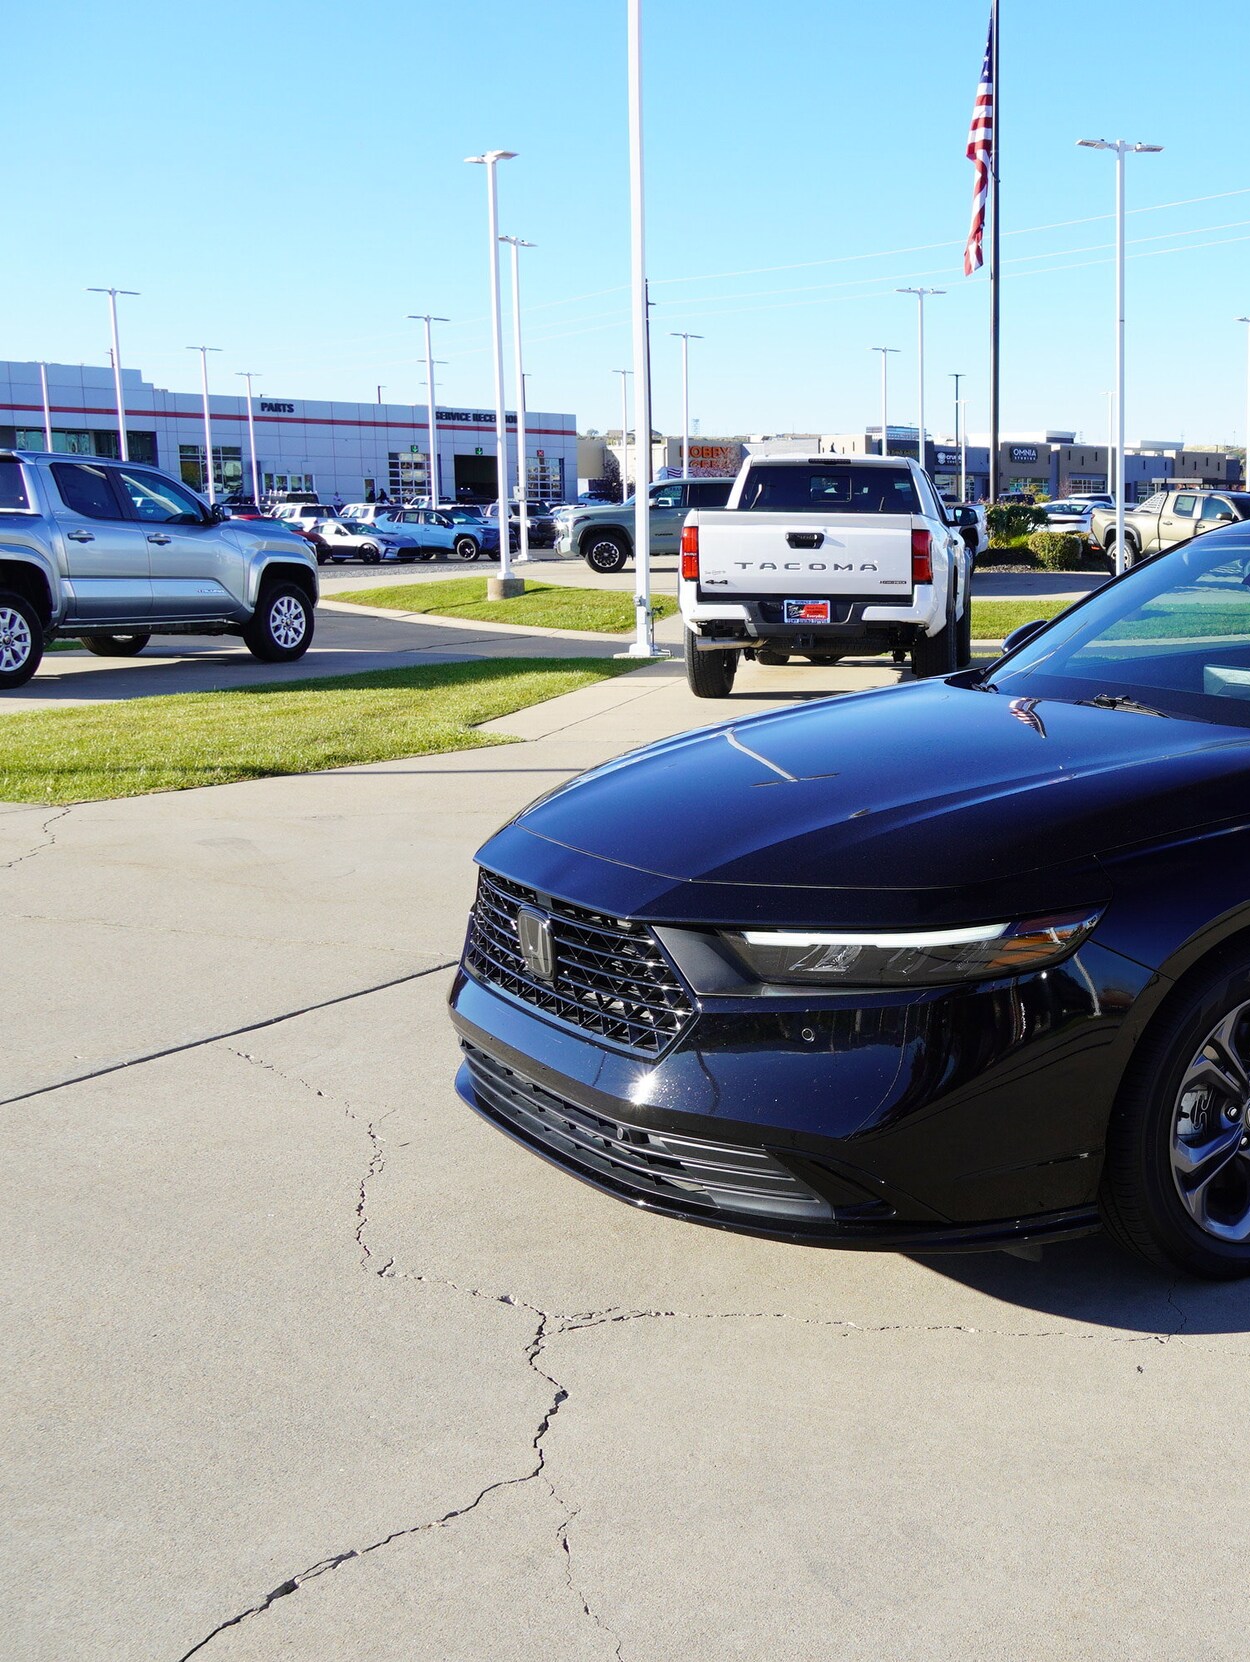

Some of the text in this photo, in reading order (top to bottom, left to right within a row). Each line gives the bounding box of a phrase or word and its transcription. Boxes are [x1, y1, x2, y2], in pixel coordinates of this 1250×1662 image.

[261, 402, 295, 413] PARTS
[436, 411, 471, 421] SERVICE
[1013, 448, 1036, 457] OMNIA
[734, 562, 878, 571] TACOMA
